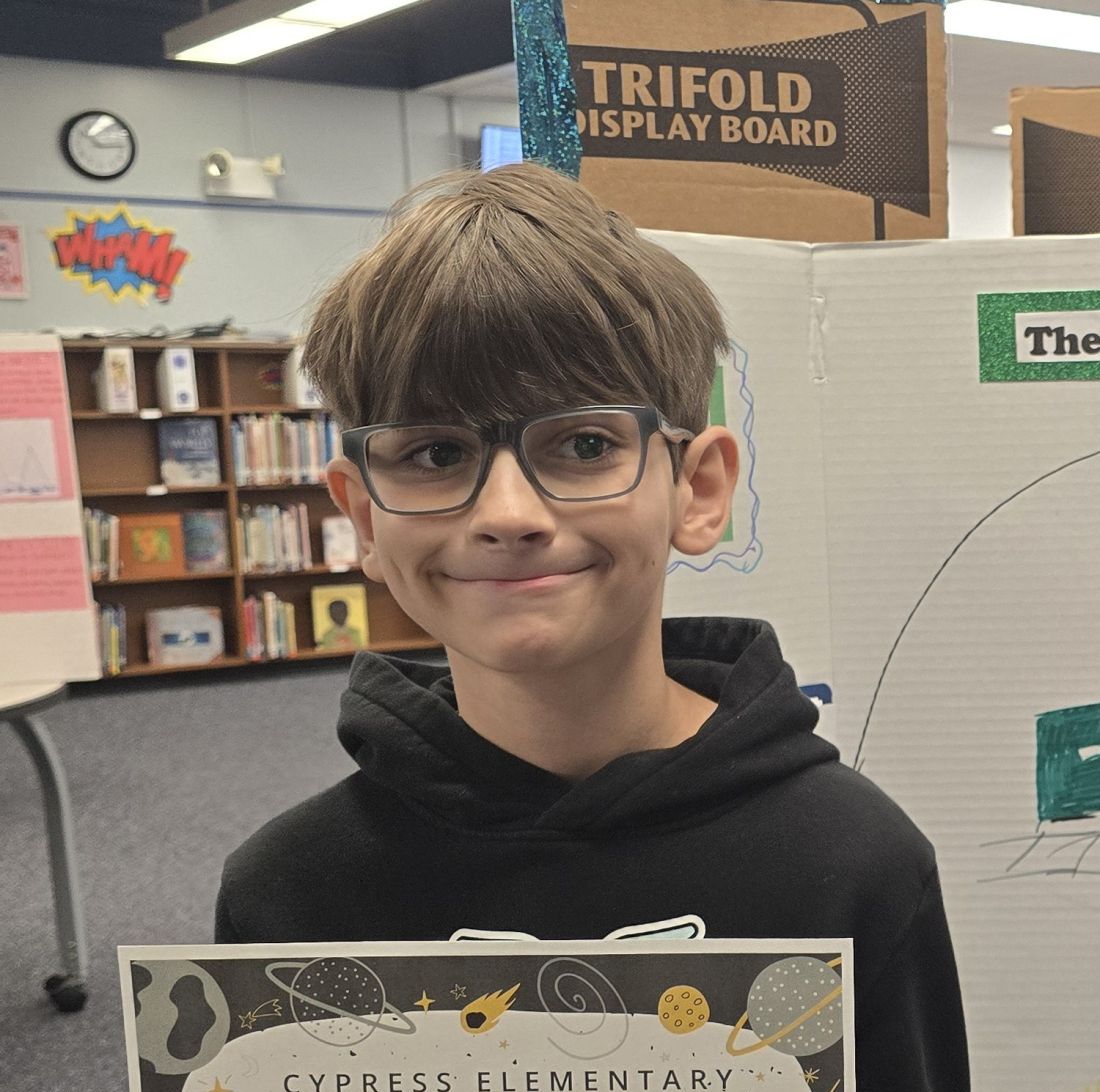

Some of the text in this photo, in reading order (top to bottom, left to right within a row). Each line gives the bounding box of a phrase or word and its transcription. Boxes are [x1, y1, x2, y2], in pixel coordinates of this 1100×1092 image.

[582, 60, 813, 114] TRIFOLD
[720, 115, 838, 148] BOARD
[477, 1068, 733, 1092] ELEMENTARY
